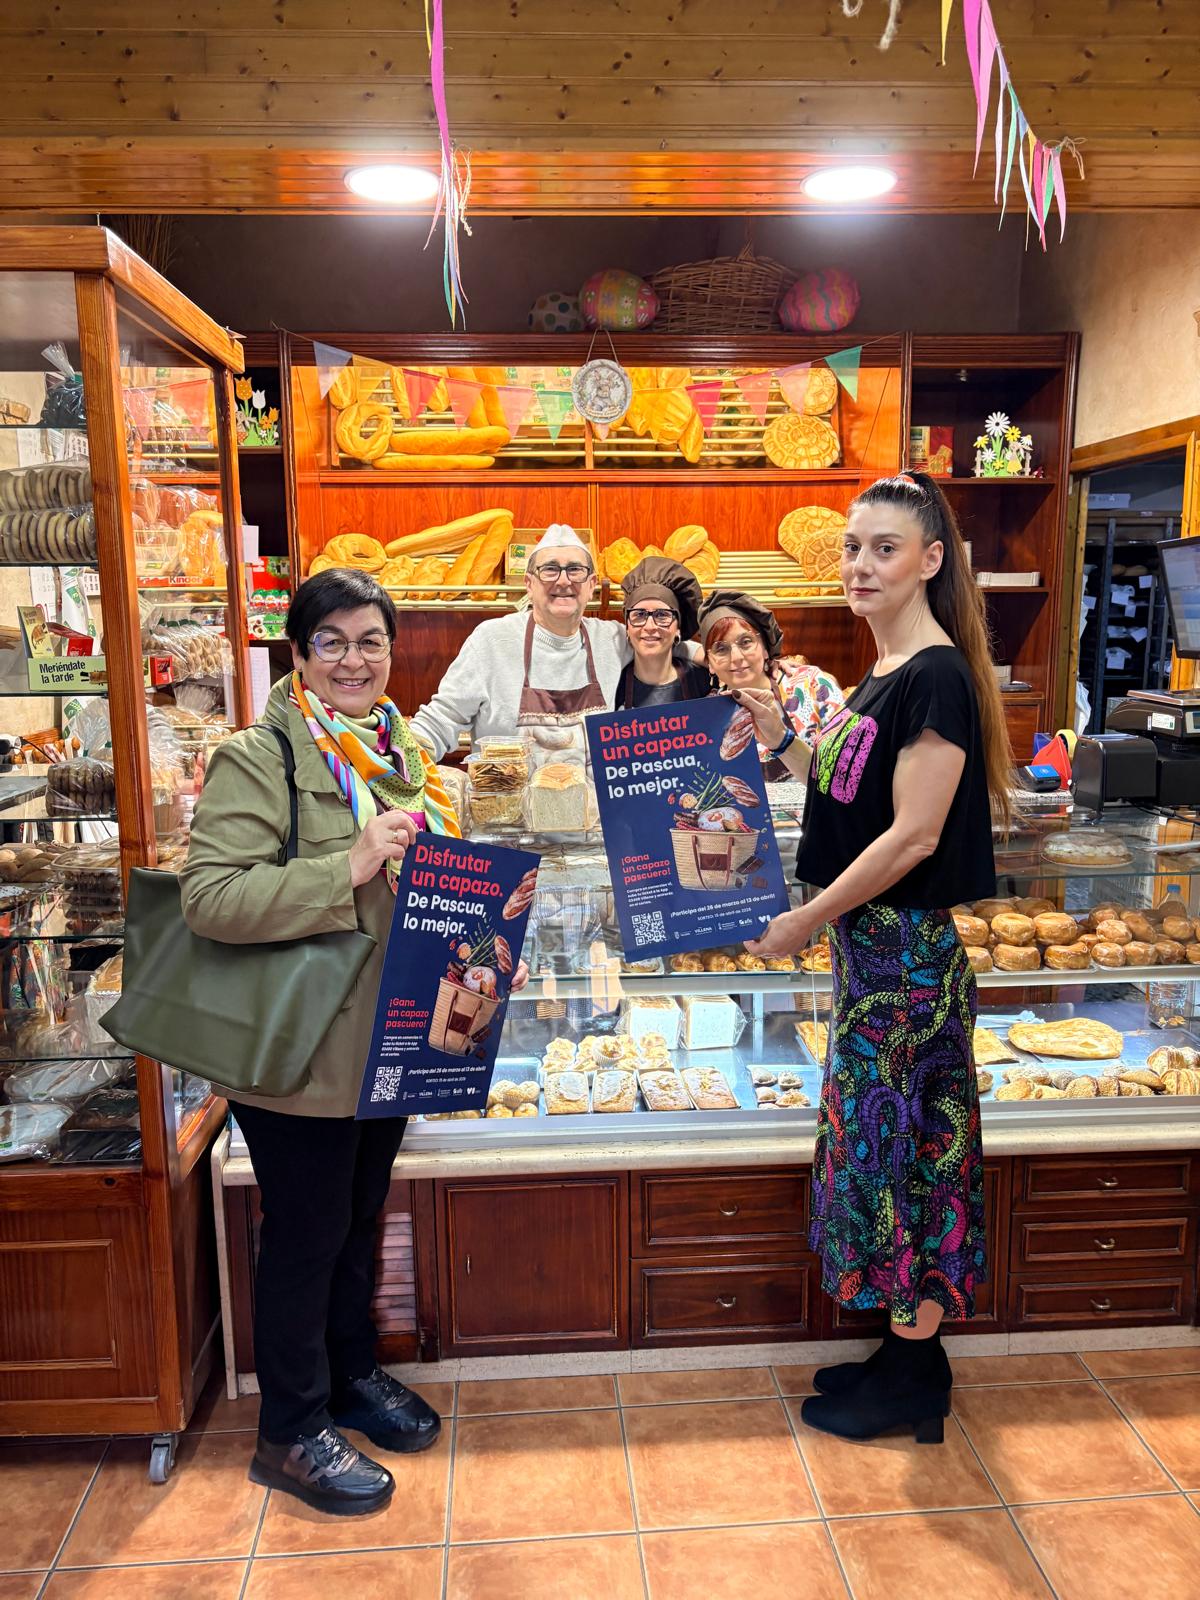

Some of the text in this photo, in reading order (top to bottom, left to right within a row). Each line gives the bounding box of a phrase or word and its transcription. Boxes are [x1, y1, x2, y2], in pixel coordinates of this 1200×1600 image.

[39, 660, 85, 673] Meriéndate
[41, 672, 74, 684] la tarde
[600, 715, 689, 742] Disfrutar
[603, 732, 713, 760] un capazo.
[605, 755, 700, 780] De Pascua,
[608, 776, 684, 799] lo mejor.
[415, 844, 492, 874] Disfrutar
[622, 854, 649, 866] ¡Gana
[636, 860, 670, 871] capazo
[412, 870, 503, 897] un capazo.
[624, 867, 671, 885] pascuero!
[407, 892, 486, 918] De Pascua,
[403, 912, 467, 938] lo mejor.
[389, 998, 416, 1008] ¡Gana
[385, 1020, 427, 1030] pascuero!
[400, 1010, 429, 1020] capazo
